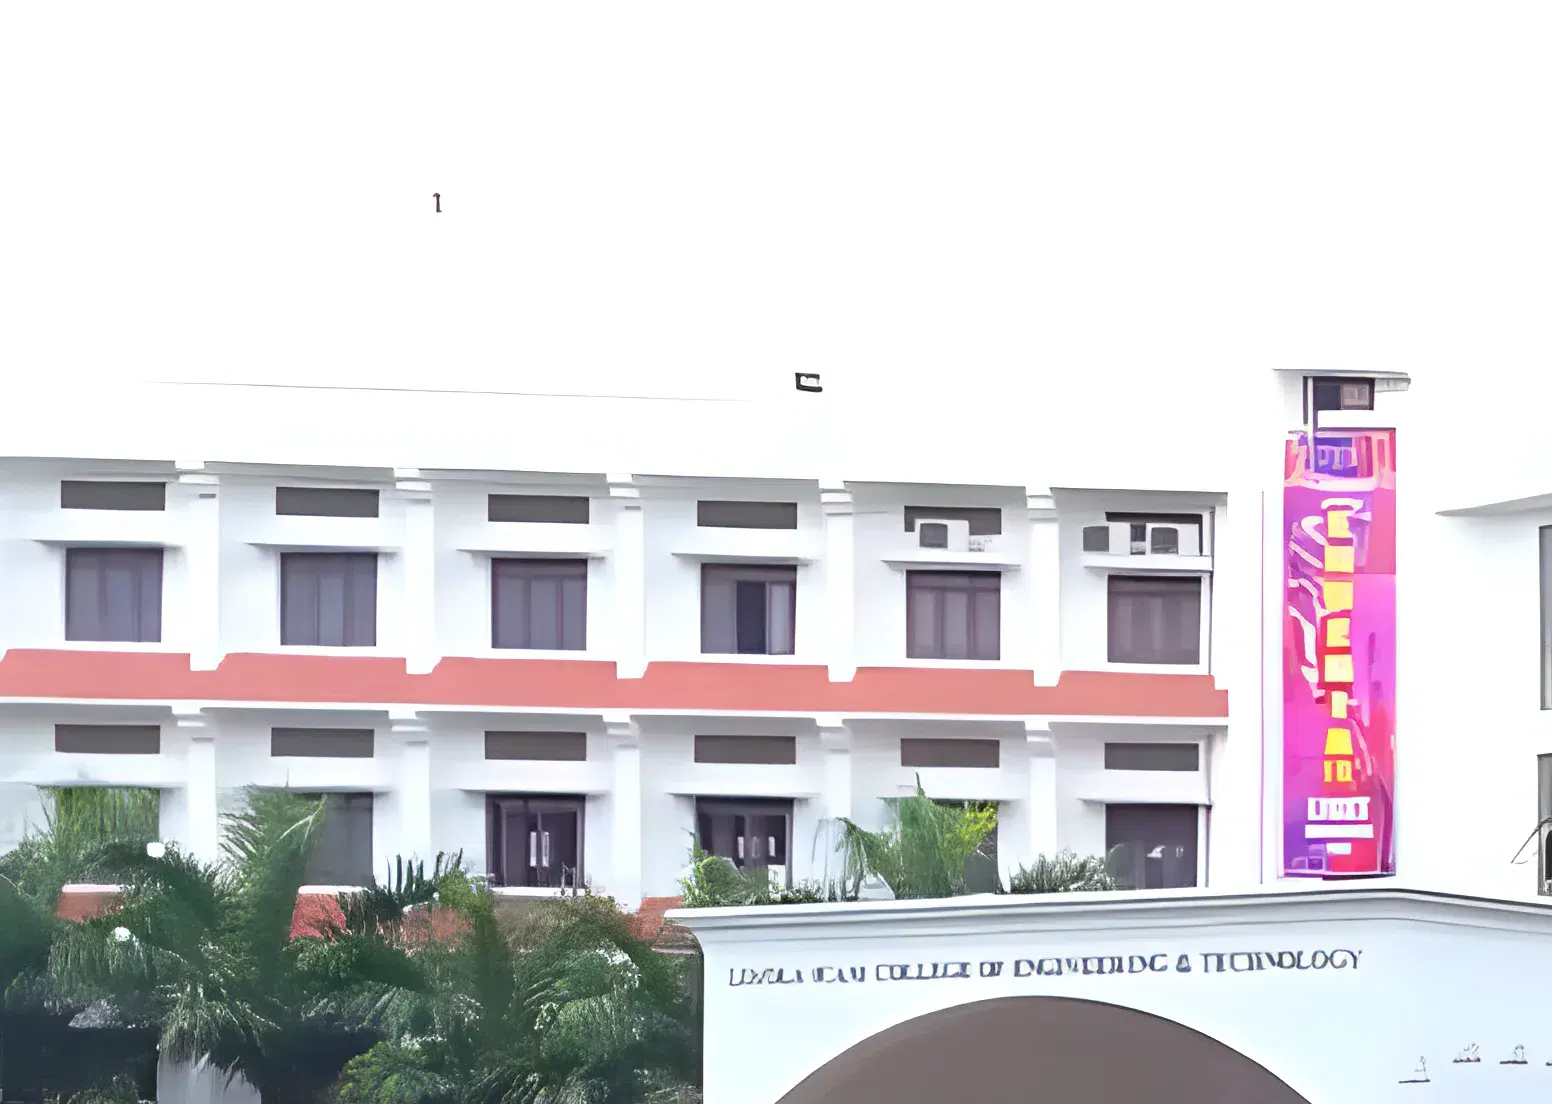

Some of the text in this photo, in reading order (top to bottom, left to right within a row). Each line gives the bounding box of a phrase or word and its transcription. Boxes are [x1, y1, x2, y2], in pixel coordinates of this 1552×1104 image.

[876, 961, 972, 981] COLLEGE
[978, 961, 1004, 978] OF
[1013, 953, 1168, 978] ENGINEERING
[1175, 953, 1192, 973] &
[1199, 948, 1364, 974] TECHNOLOGY
